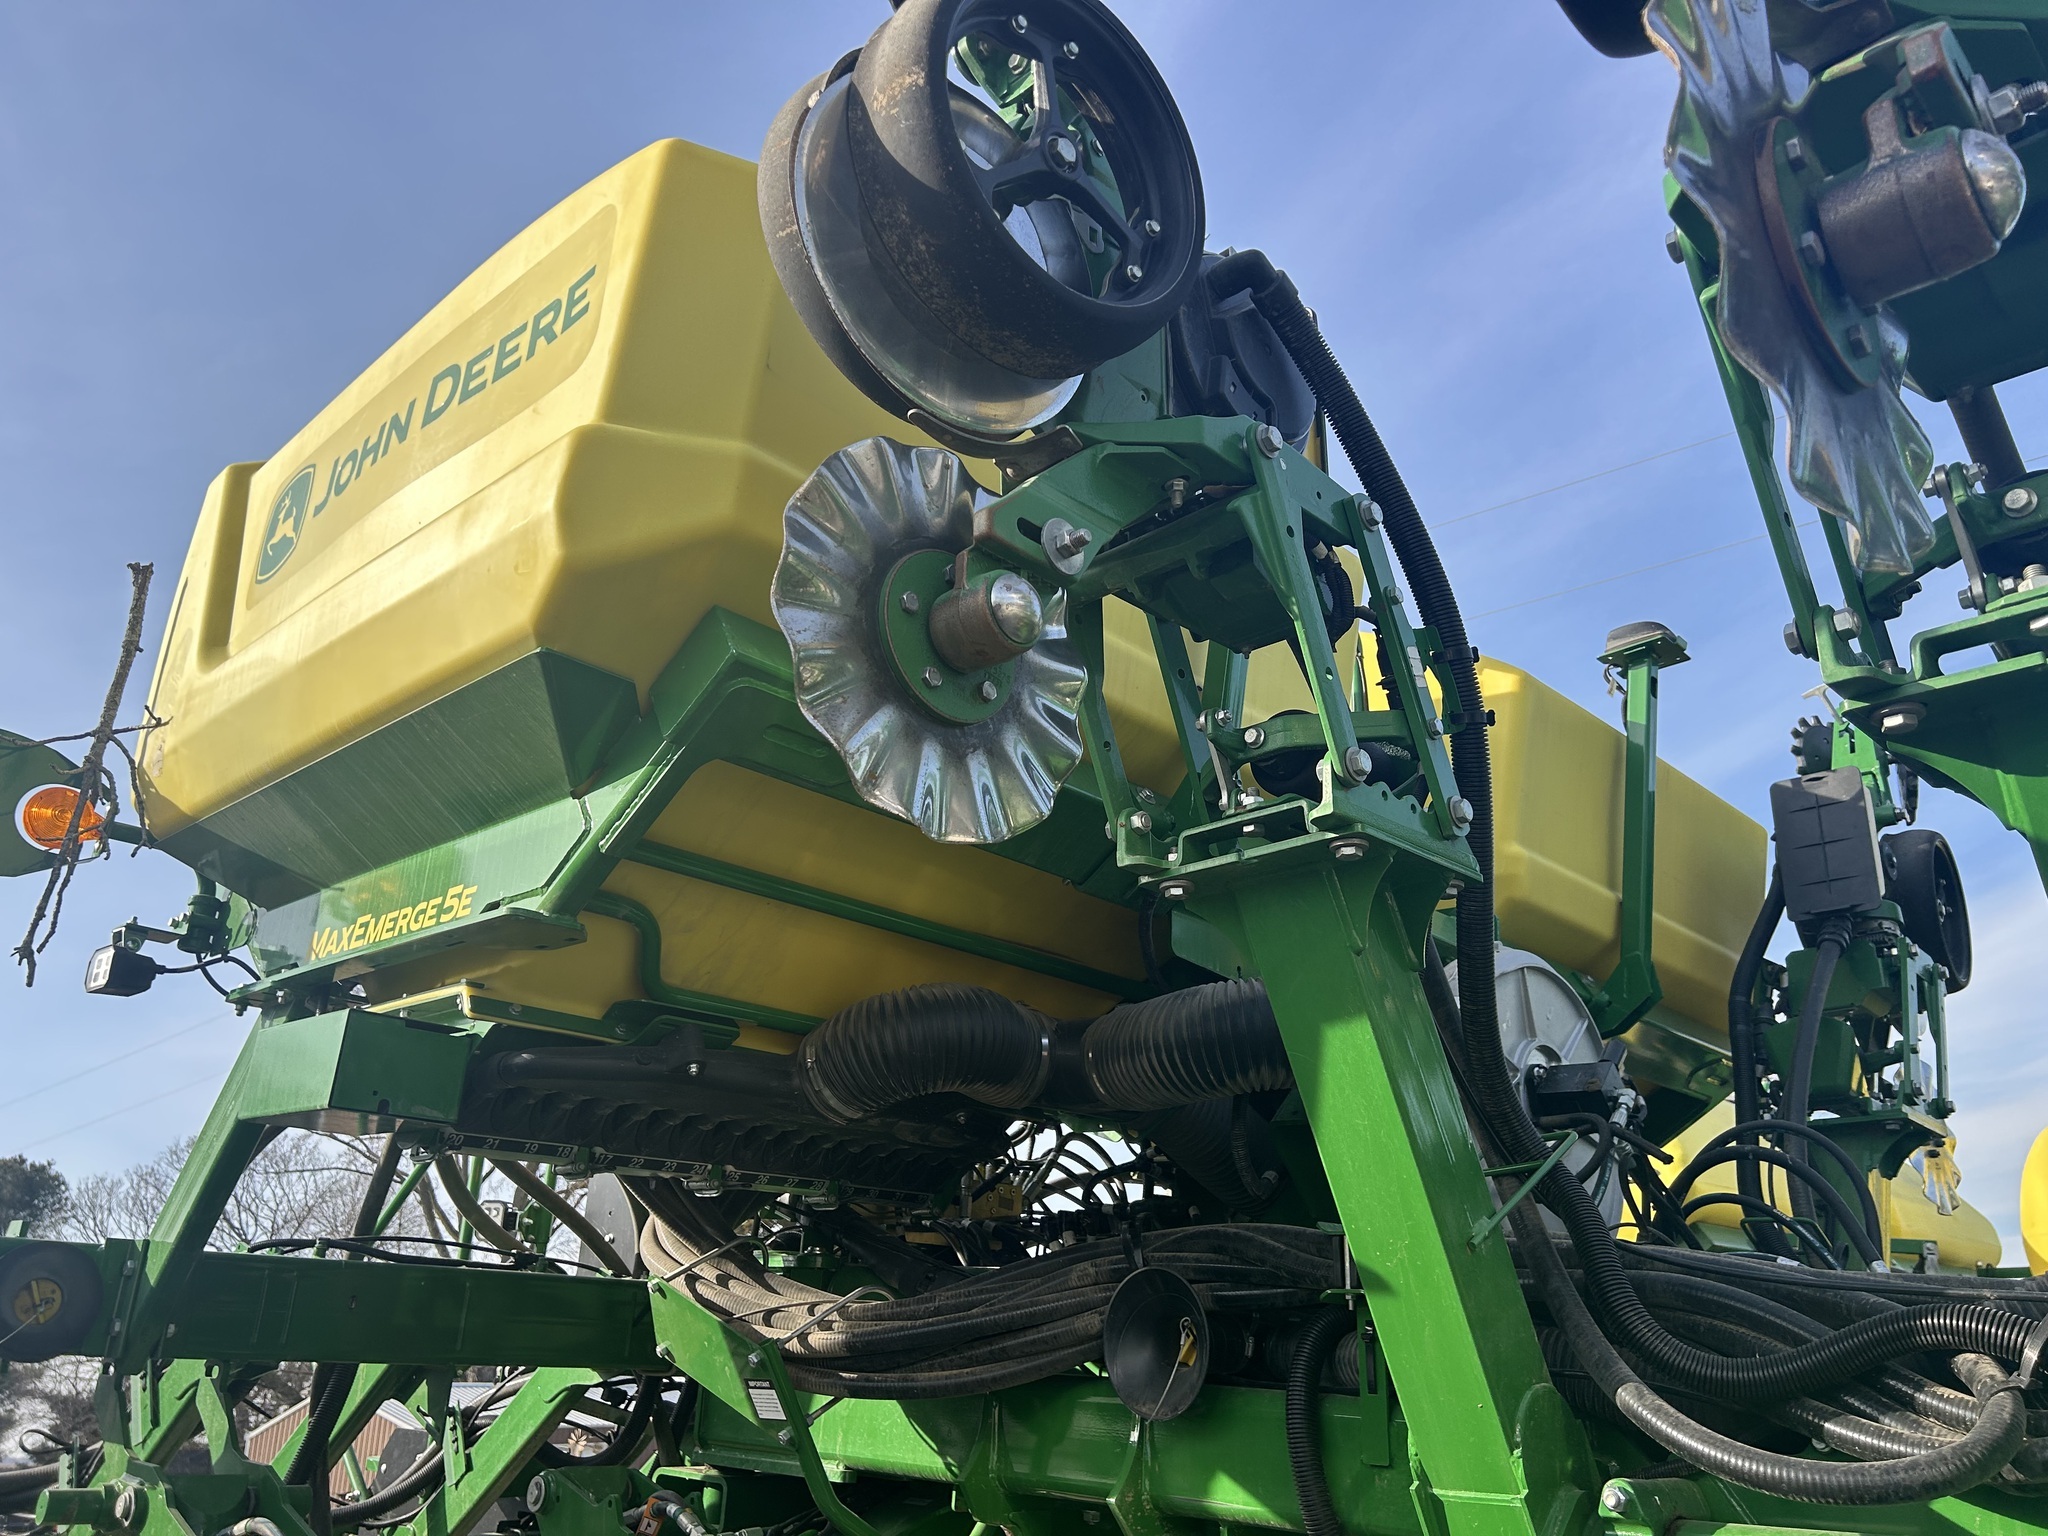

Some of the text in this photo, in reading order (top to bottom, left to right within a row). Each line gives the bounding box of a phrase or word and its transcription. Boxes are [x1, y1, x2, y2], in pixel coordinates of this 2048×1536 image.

[313, 264, 597, 518] JOHN DEERE
[440, 884, 478, 923] 5E
[447, 1133, 572, 1158] 20 21 19 18
[598, 1154, 706, 1175] 17 22 23 24
[727, 1172, 825, 1191] 25 26 27 28
